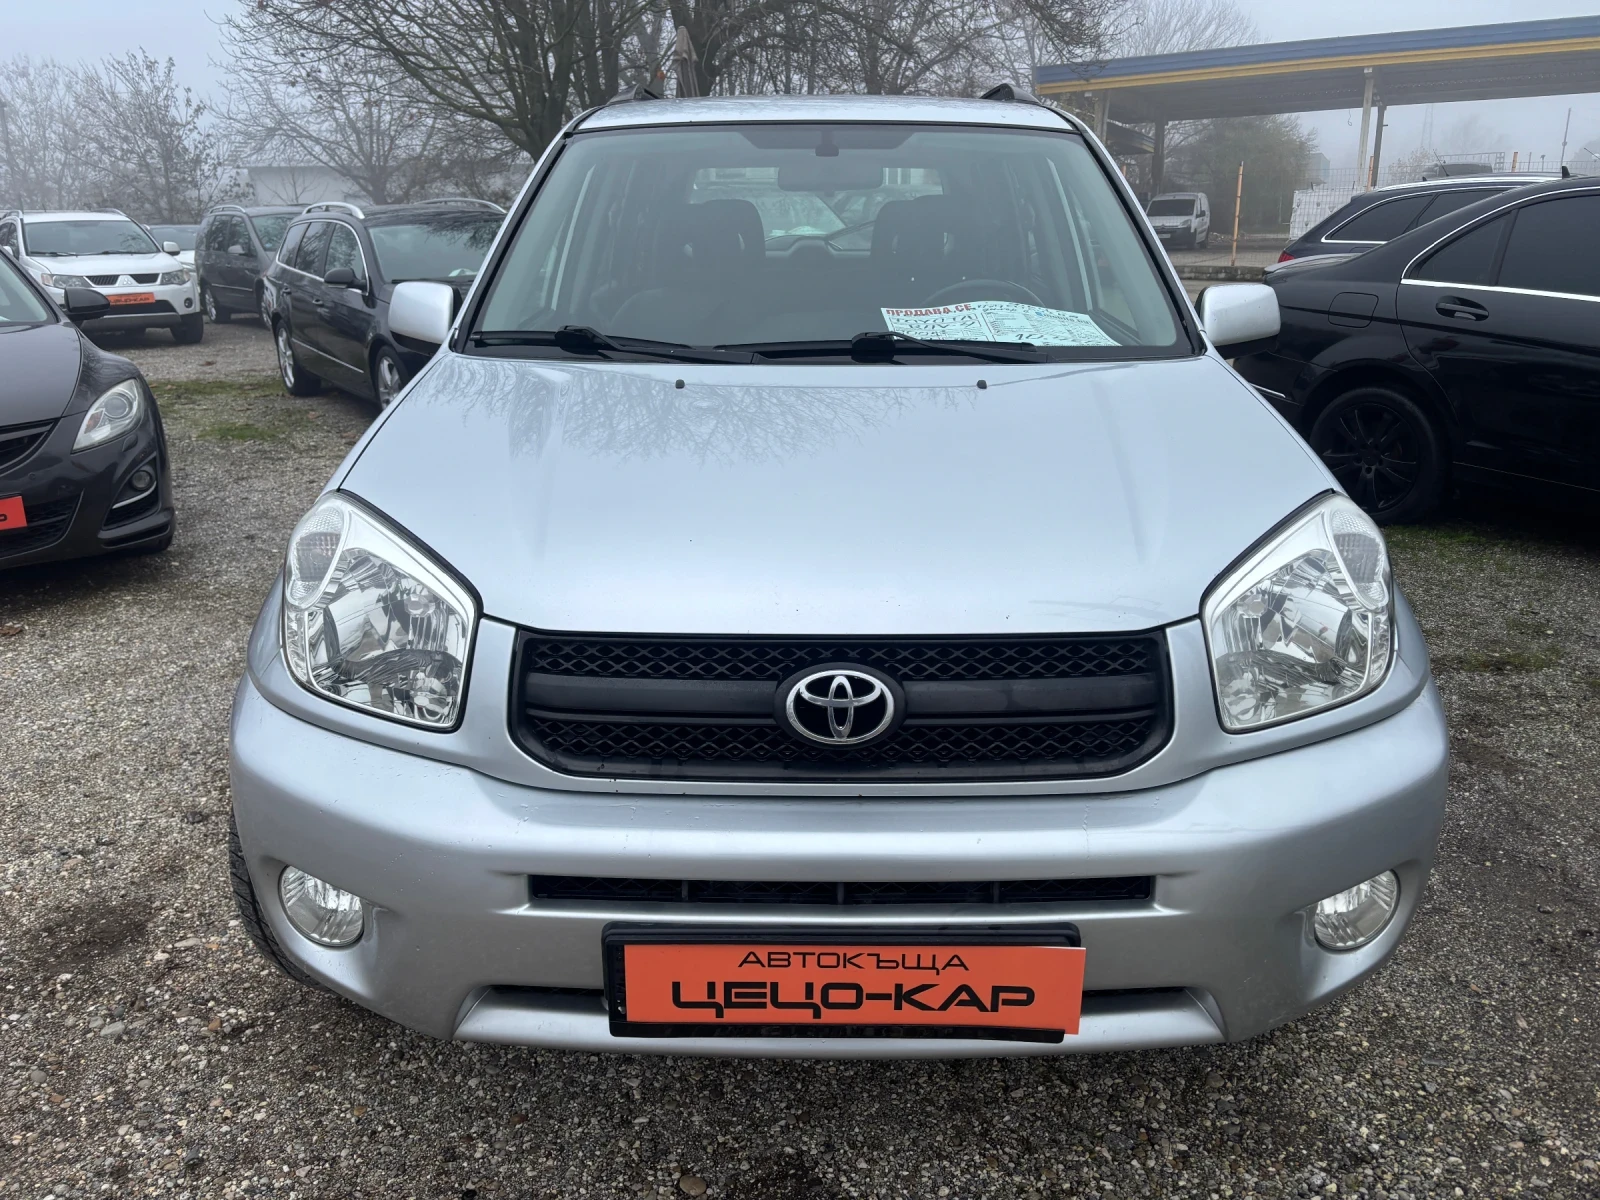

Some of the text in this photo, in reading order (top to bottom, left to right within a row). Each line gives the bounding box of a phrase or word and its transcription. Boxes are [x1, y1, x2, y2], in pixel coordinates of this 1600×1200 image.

[886, 307, 952, 317] ПРОДАВА
[955, 303, 972, 312] СЕ
[738, 951, 969, 976] АВТОКЪЩА
[672, 981, 1036, 1020] ЦЕЦО-КАР
